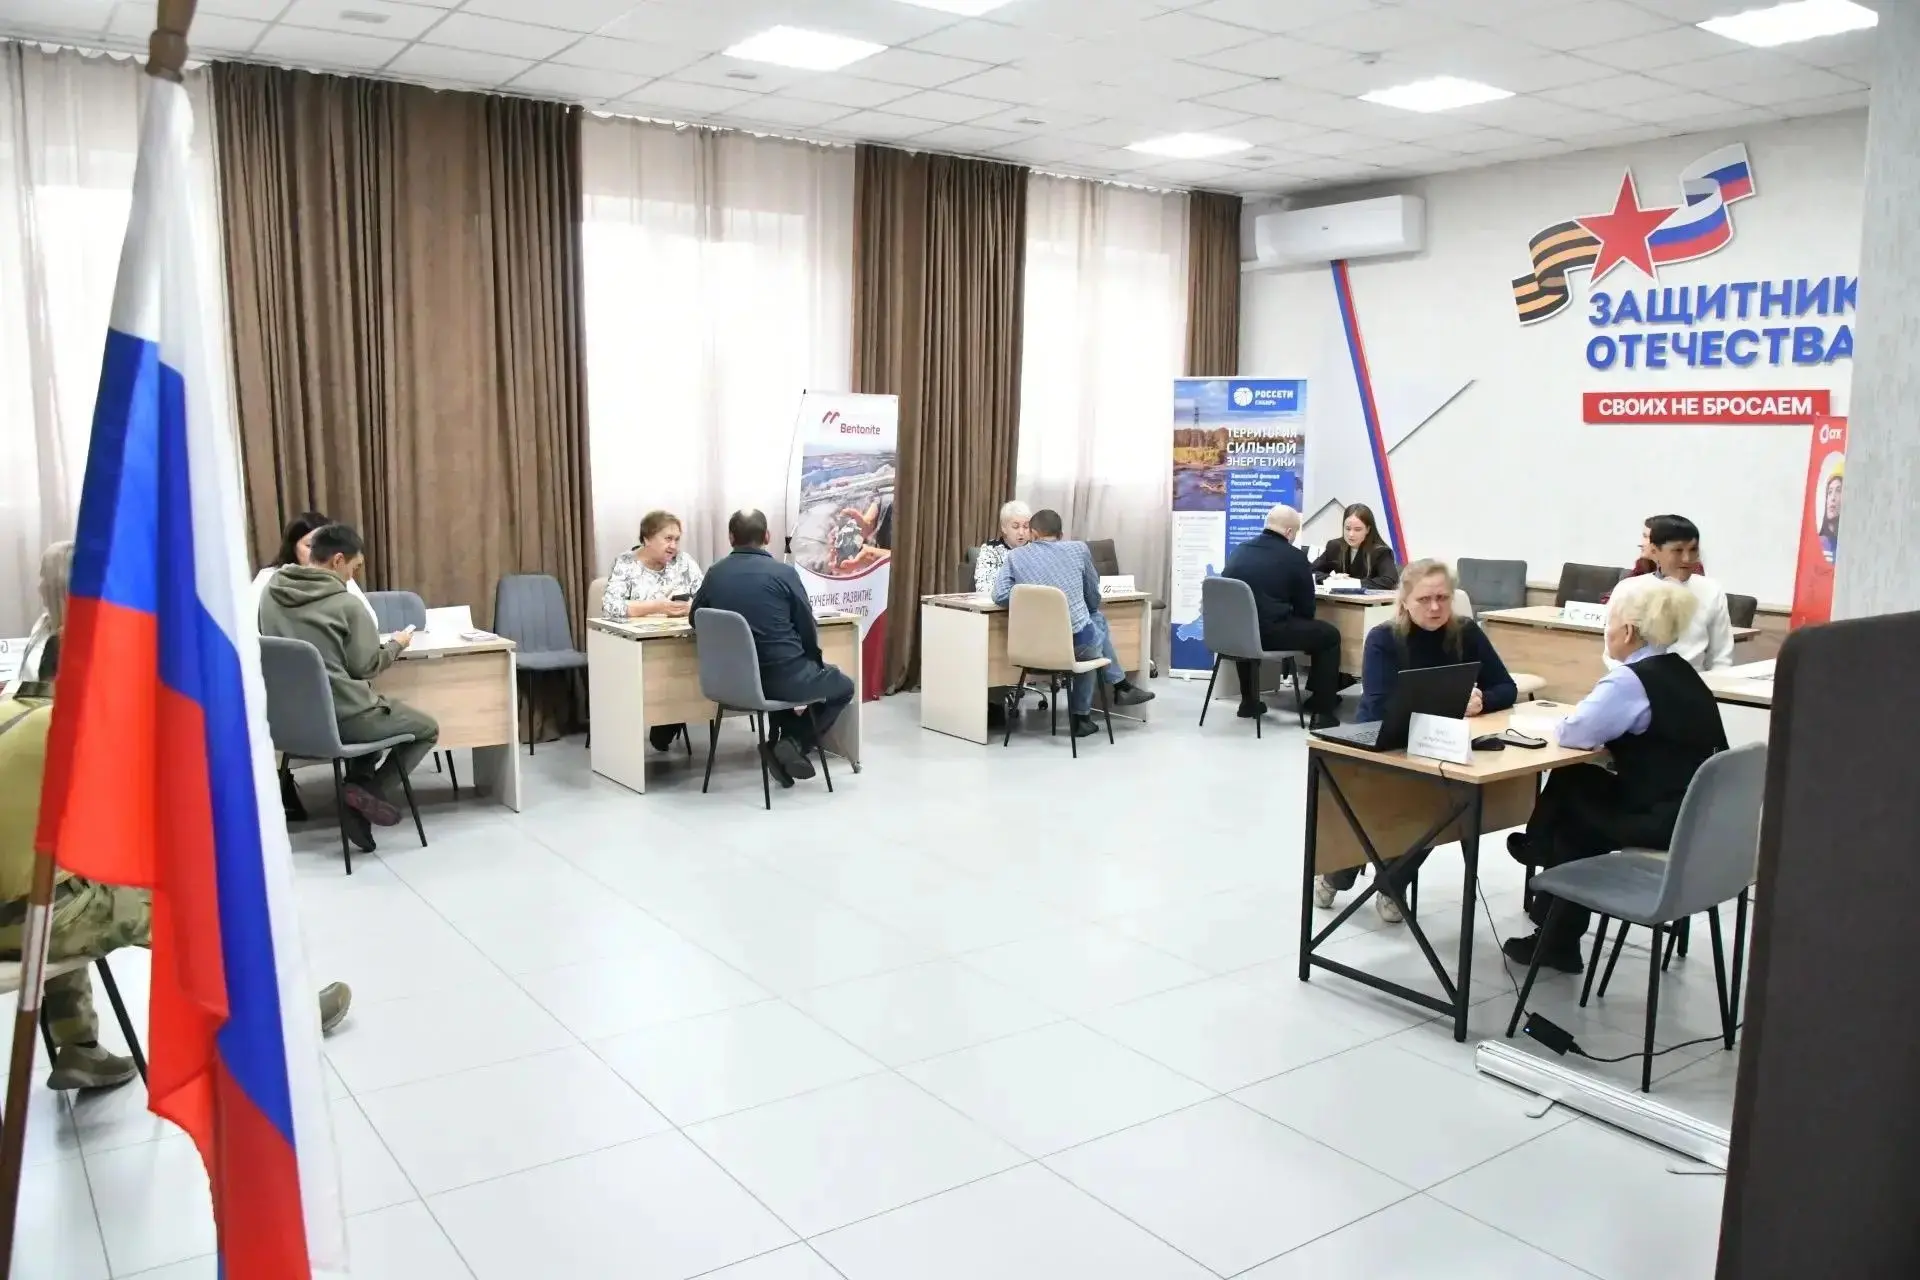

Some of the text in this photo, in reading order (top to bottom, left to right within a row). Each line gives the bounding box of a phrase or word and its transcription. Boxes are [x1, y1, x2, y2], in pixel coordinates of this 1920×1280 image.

[1587, 325, 1853, 369] ОТЕЧЕСТВА
[1255, 390, 1294, 399] РОССЕТИ
[1598, 396, 1812, 416] СВОИХ НЕ БРОСАЕМ
[840, 423, 881, 435] Bentonite
[1228, 427, 1297, 438] ТЕРРИТОРИЯ
[1226, 440, 1297, 454] СИЛЬНОЙ
[1226, 456, 1296, 467] ЭНЕРГЕТИКИ
[809, 589, 872, 607] БУЧЕНИЕ, РАЗВИТИЕ
